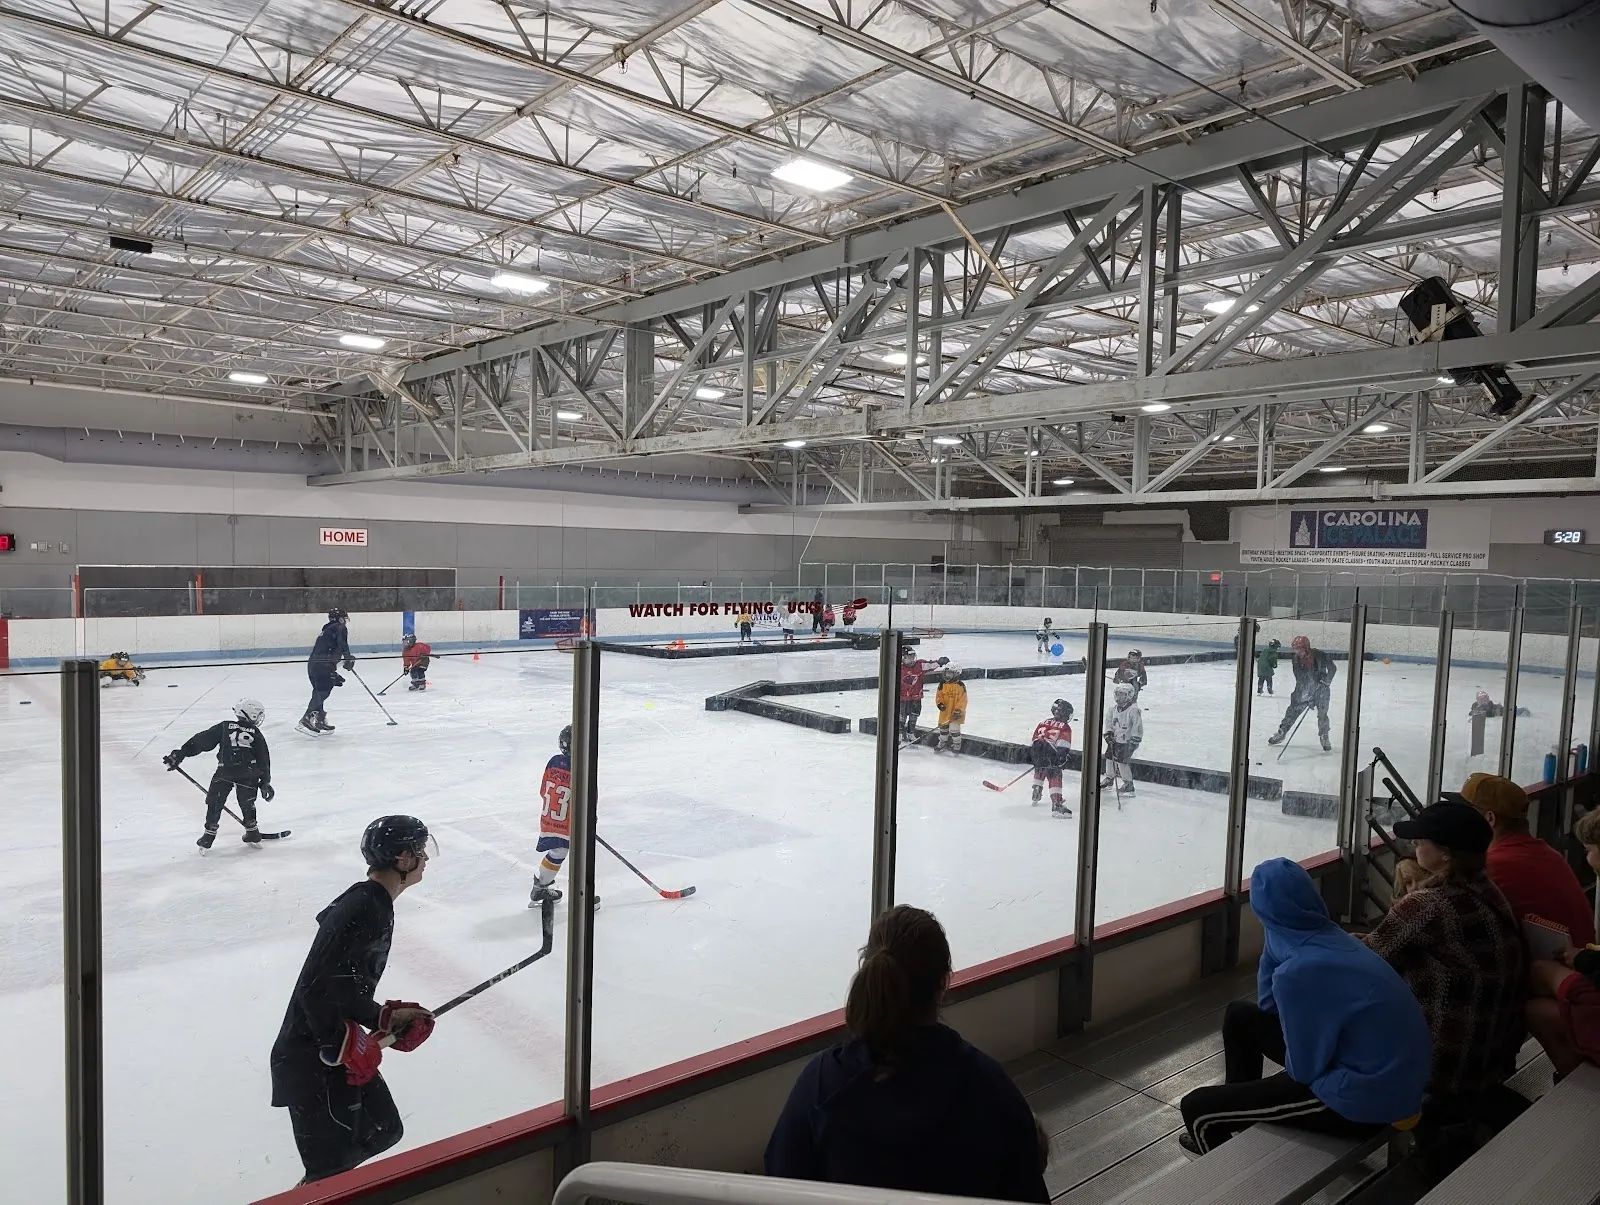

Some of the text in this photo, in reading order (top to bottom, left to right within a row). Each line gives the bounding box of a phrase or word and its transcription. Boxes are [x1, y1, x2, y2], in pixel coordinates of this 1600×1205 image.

[1323, 511, 1422, 526] CAROLINA
[323, 531, 364, 542] HOME
[1323, 525, 1421, 544] ICE PALACE
[1554, 531, 1580, 543] 5:28
[628, 601, 821, 617] WATCH FOR FLYING UCKS
[541, 780, 571, 822] 53
[489, 964, 520, 986] CCM
